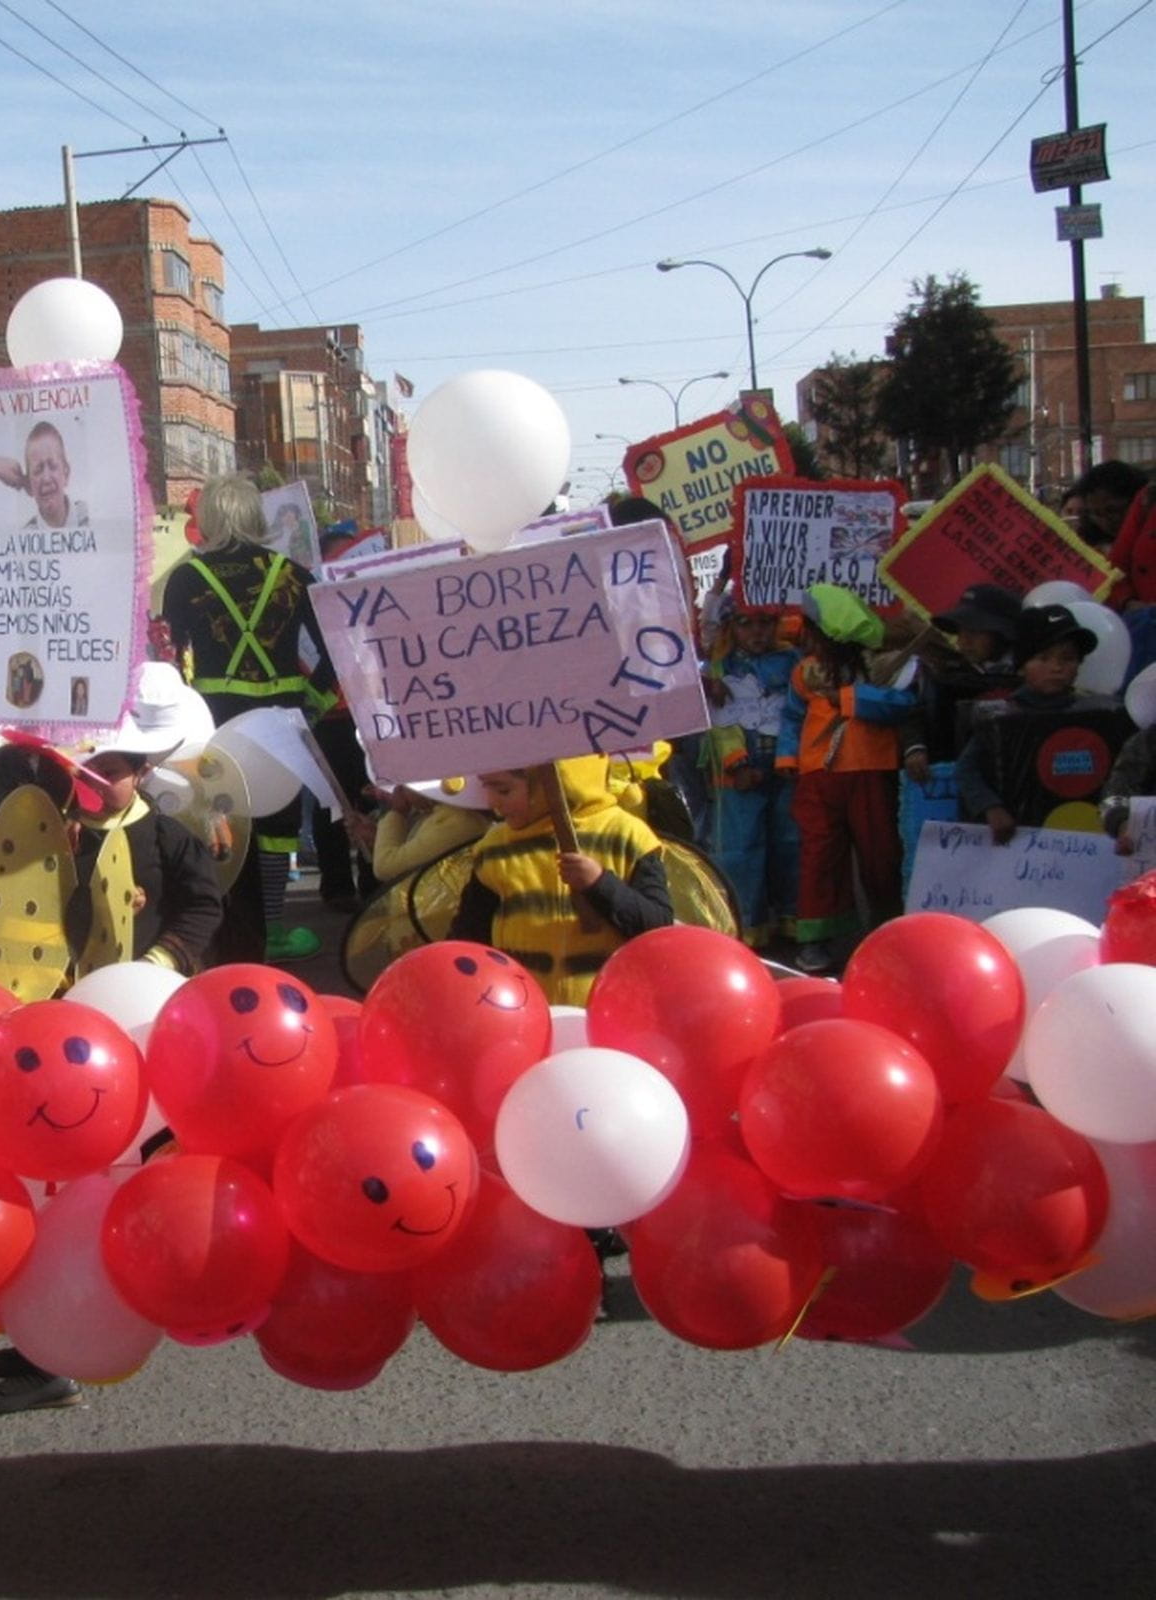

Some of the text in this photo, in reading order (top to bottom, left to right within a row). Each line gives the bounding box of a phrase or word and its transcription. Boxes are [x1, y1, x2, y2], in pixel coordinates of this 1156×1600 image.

[684, 439, 728, 474] NO
[659, 453, 775, 513] AL BULLYING
[749, 492, 834, 518] APRENDER
[19, 531, 97, 554] VIOLENCIA
[762, 520, 808, 546] VIVIR
[28, 559, 61, 581] SUS
[745, 544, 807, 568] JUNTOS
[338, 586, 409, 627] YA
[436, 553, 596, 616] BORRA
[610, 549, 657, 587] DE
[43, 608, 91, 634] NIÑOS
[364, 602, 609, 668] TU CABEZA
[382, 672, 456, 706] LAS
[584, 626, 685, 756] ALTO
[373, 698, 582, 741] DIFERENCIAS
